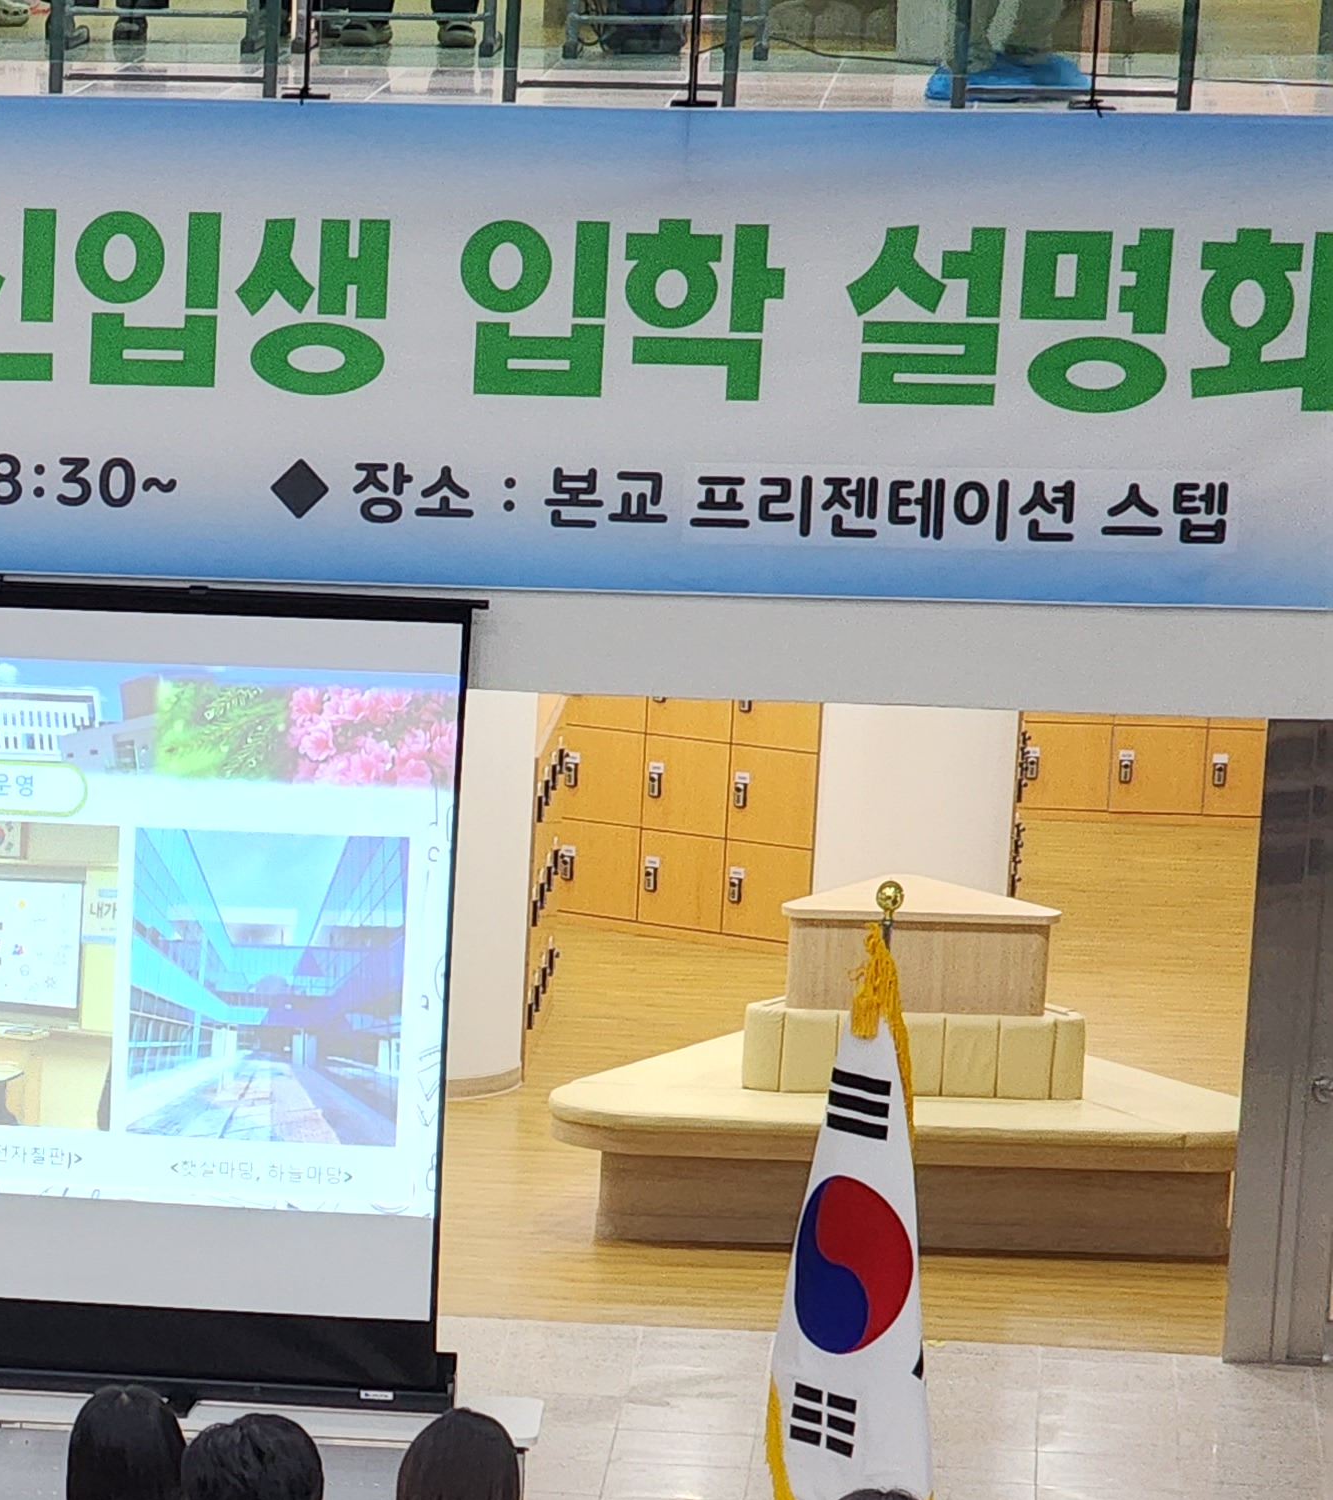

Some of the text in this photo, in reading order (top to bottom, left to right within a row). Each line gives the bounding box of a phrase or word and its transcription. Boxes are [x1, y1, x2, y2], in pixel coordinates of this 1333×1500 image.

[460, 219, 785, 401] 입학
[846, 225, 1333, 413] 설명회
[352, 462, 475, 524] 장소
[544, 466, 668, 529] 본교
[689, 474, 1076, 542] 프리젠테이션
[1100, 481, 1229, 545] 스텝
